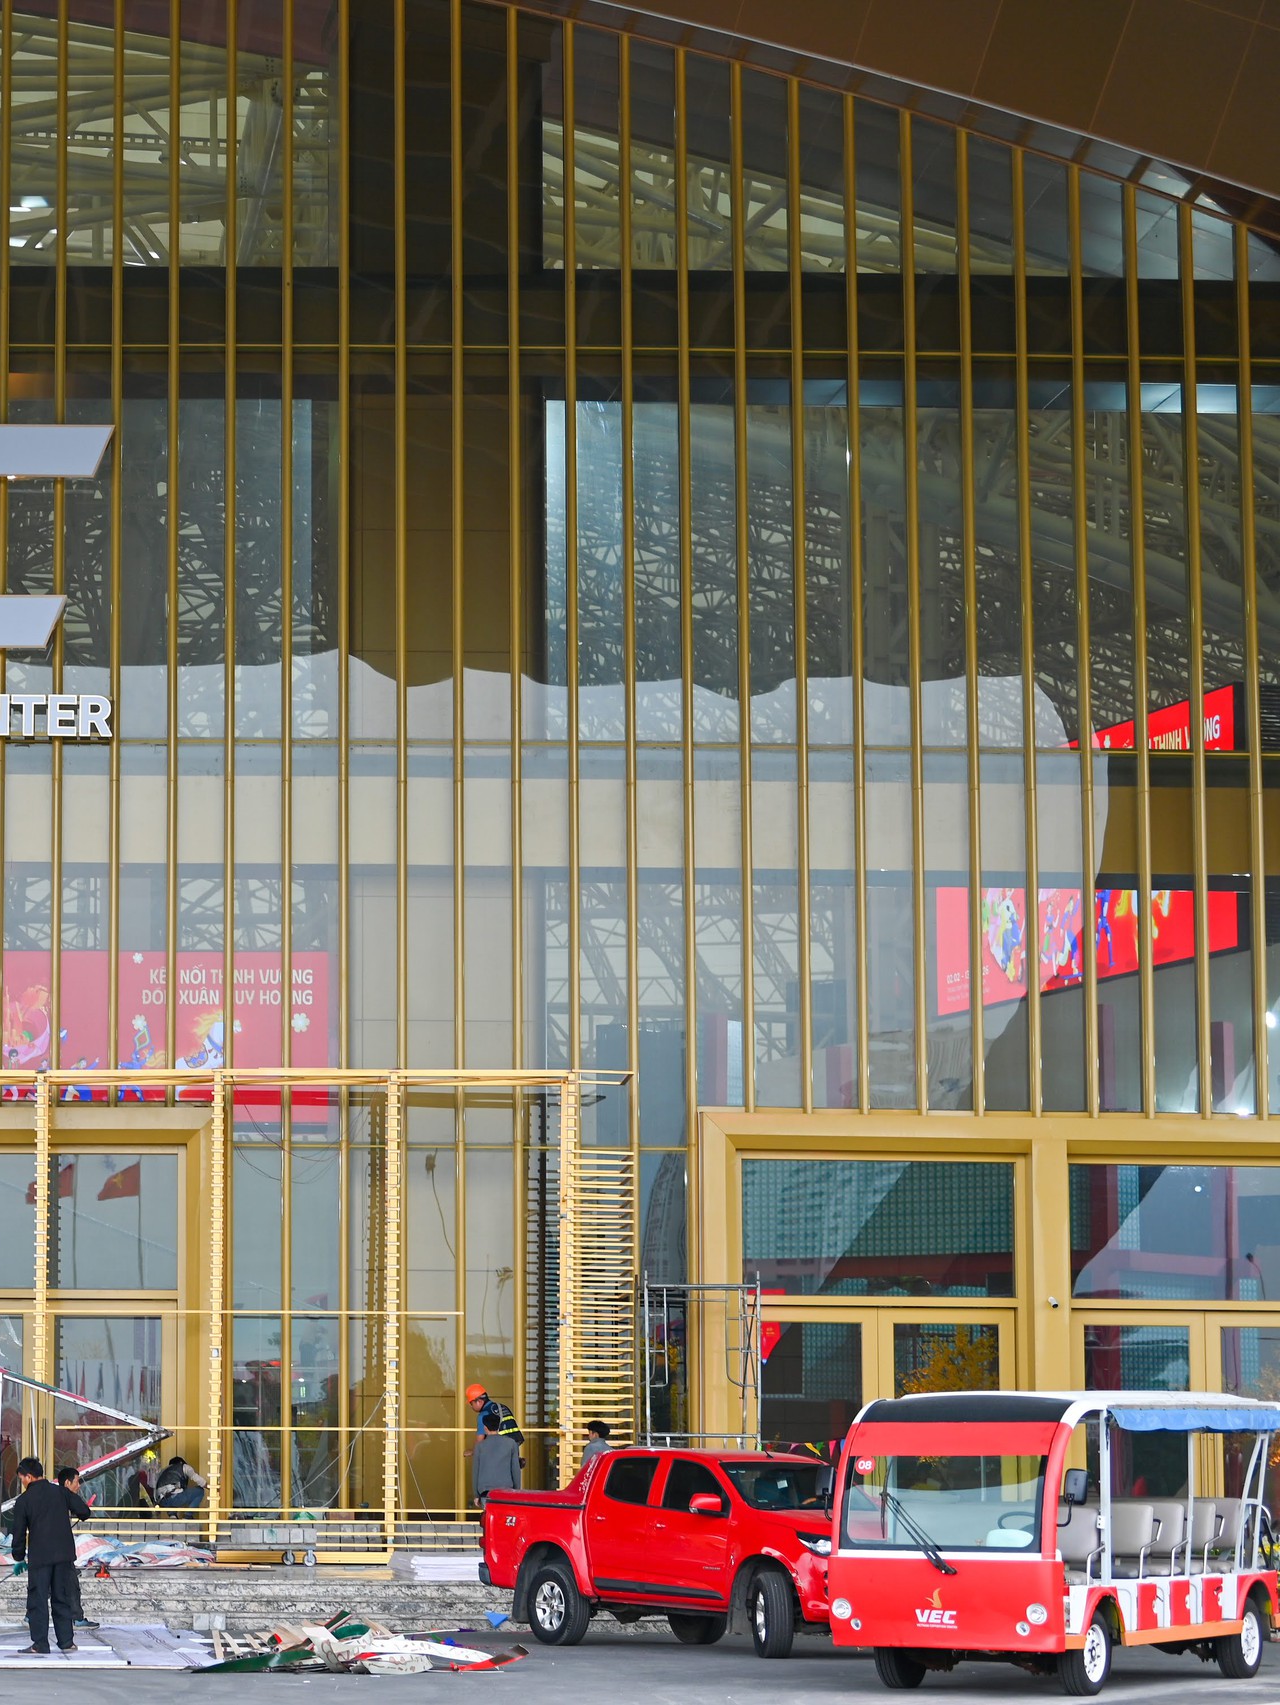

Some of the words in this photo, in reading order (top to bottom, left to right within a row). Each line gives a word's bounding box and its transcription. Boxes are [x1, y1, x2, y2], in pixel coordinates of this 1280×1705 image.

[180, 964, 206, 984] NỐI
[210, 969, 254, 984] TNH
[259, 968, 313, 984] VƯNG
[142, 986, 167, 1005] ĐÓ
[179, 986, 220, 1005] XUÂN
[235, 990, 255, 1005] UY
[259, 990, 313, 1005] HONG
[858, 1460, 872, 1470] 08
[915, 1608, 957, 1624] VEC
